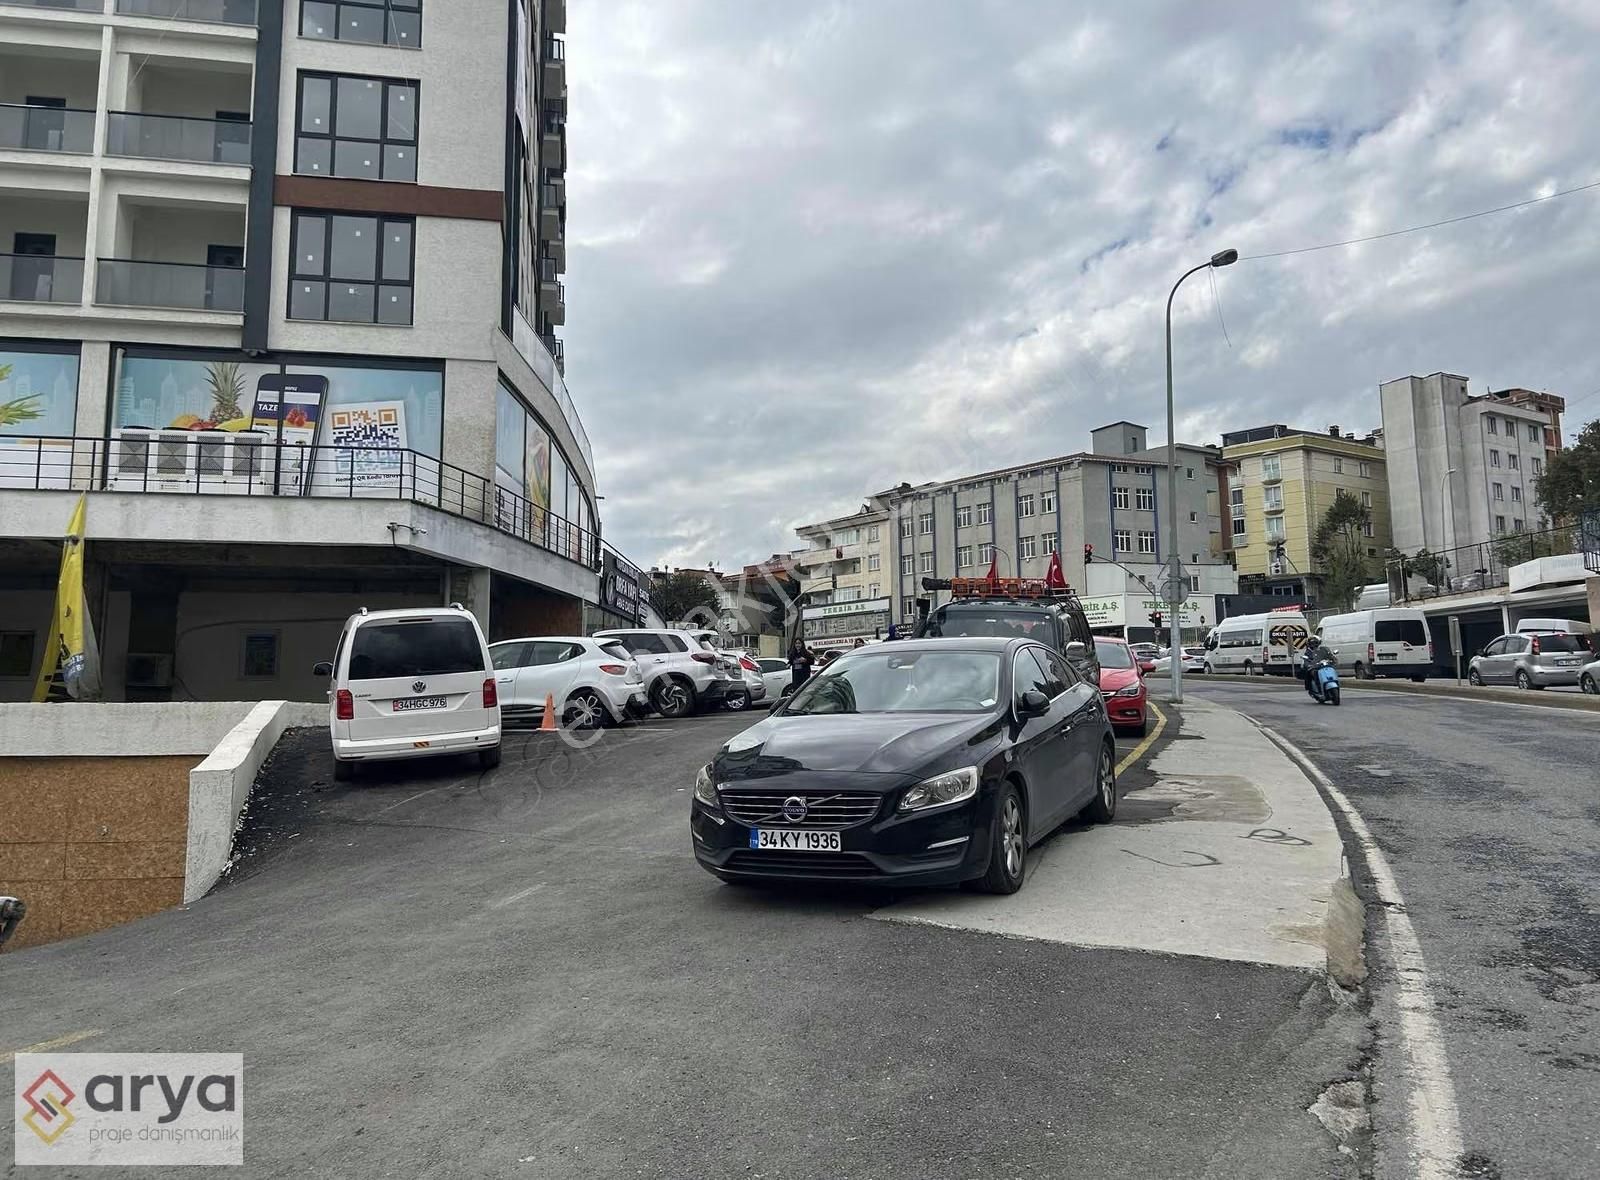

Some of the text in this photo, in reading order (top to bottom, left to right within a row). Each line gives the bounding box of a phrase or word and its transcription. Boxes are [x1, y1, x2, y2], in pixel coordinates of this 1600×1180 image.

[258, 403, 279, 412] TAZE
[760, 831, 777, 847] 34
[780, 831, 801, 848] KY
[805, 832, 840, 849] 1936
